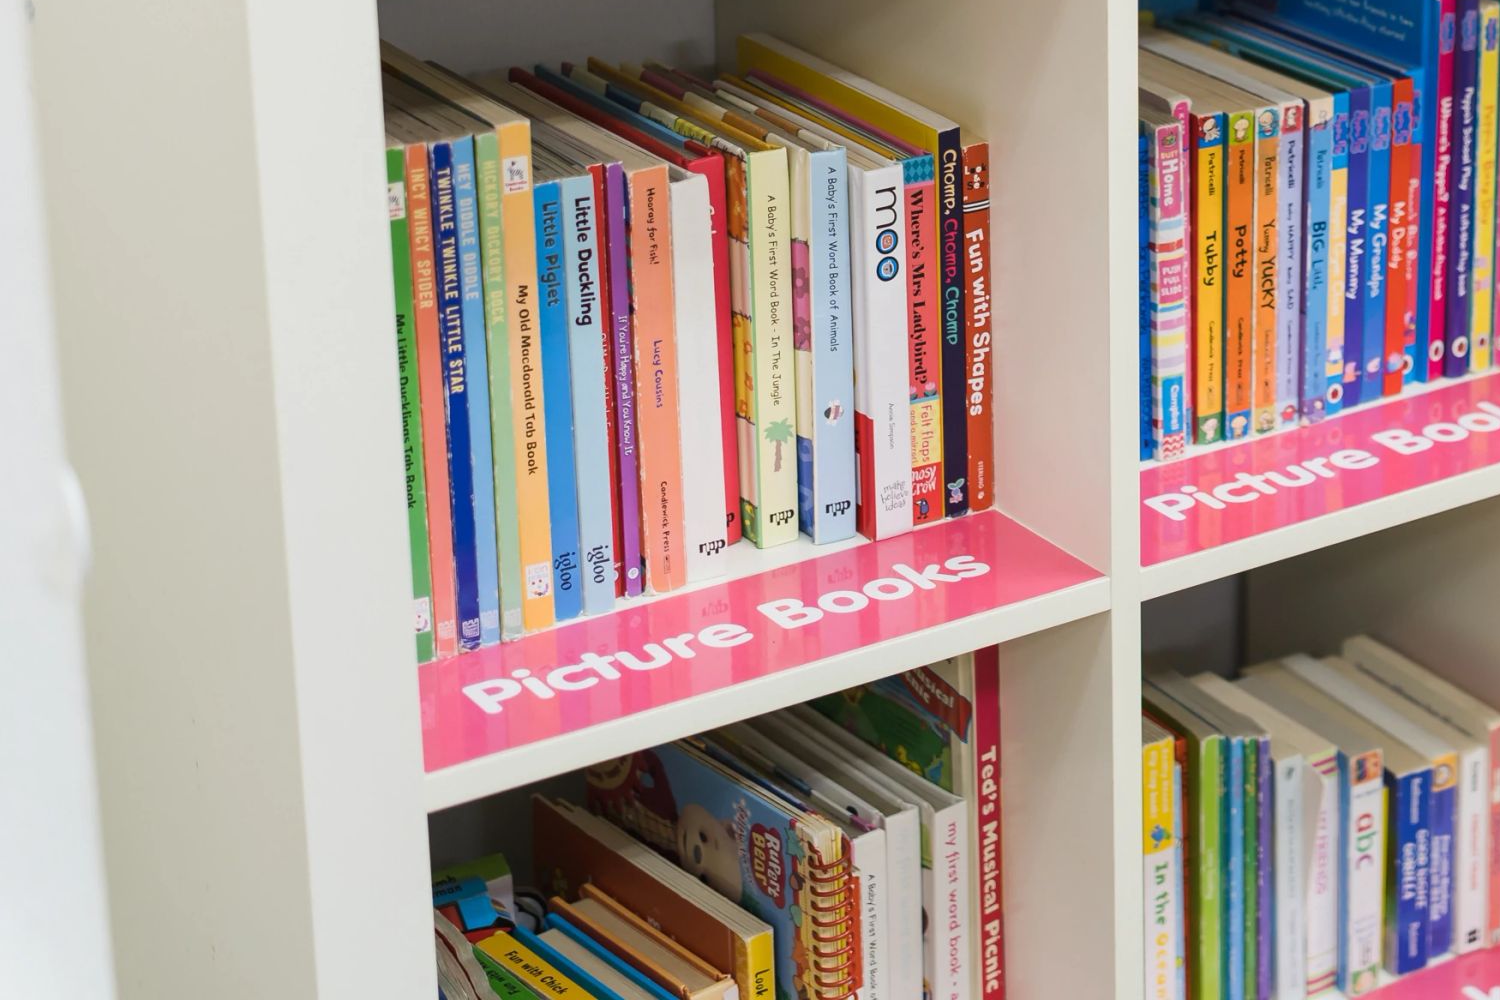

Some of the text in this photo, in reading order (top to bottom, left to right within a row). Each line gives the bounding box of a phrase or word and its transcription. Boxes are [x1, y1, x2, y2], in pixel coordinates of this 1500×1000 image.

[1439, 96, 1452, 152] Where's
[1461, 86, 1475, 124] Peppa's
[1462, 126, 1472, 165] School
[827, 178, 836, 209] Baby's
[1162, 158, 1179, 207] Home
[1435, 155, 1451, 202] Peppa?
[1459, 166, 1472, 190] Play
[410, 168, 433, 309] INCY WINCY SPIDER
[458, 164, 479, 301] HEY DIDDLE DIDDLE
[646, 188, 659, 266] Hooray for Fish!
[766, 205, 777, 237] Baby's
[828, 212, 838, 238] First
[876, 186, 899, 282] moo
[1203, 152, 1218, 286] Patricelli Tubby
[1259, 219, 1275, 254] Yummy
[1312, 222, 1326, 251] BIG
[1388, 201, 1406, 269] My Daddy
[541, 201, 560, 307] Little Piglet
[575, 196, 594, 326] Little Duckling
[769, 240, 778, 265] First
[829, 240, 838, 269] Word
[944, 149, 959, 345] Chomp, Chomp, Chomp
[1233, 224, 1248, 278] Potty
[1345, 209, 1365, 299] My Mummy
[1367, 204, 1388, 298] My Grandpa
[438, 168, 464, 394] TWINKLE TWINKLE LITTLE STAR
[769, 269, 778, 298] Word
[829, 272, 839, 297] Book
[910, 190, 927, 384] Where's Mrs Ladybird?
[1261, 256, 1276, 310] YUCKY
[770, 300, 779, 325] Book
[830, 299, 839, 311] of
[966, 228, 991, 416] Fun with Shapes
[771, 336, 780, 348] In
[830, 315, 839, 352] Animals
[516, 285, 536, 475] My Old Macdonald Tab Book
[620, 355, 631, 381] Happy
[653, 340, 663, 408] Lucy Cousins
[772, 353, 780, 370] The
[622, 382, 630, 400] and
[622, 400, 632, 418] You
[770, 373, 780, 406] Jungle
[1171, 384, 1180, 430] Campbell
[623, 420, 632, 444] Know
[625, 445, 634, 456] It
[919, 404, 934, 462] Felt flaps
[912, 466, 936, 482] nosy
[912, 478, 936, 496] crow
[1143, 444, 1380, 522] Picture
[660, 481, 668, 528] Candlewick
[554, 551, 576, 591] igloo
[586, 544, 610, 584] igloo
[462, 553, 991, 715] Picture Books
[753, 832, 768, 888] Bear
[1356, 812, 1374, 870] abc
[764, 831, 782, 898] Rupert
[868, 874, 875, 882] A
[982, 746, 1002, 994] Ted's Musical Picnic
[867, 883, 876, 913] Baby's
[946, 822, 962, 972] my first word book
[1155, 863, 1170, 924] In the
[504, 950, 568, 996] Fun with Chick
[869, 940, 877, 966] Word
[754, 968, 769, 997] Look
[869, 966, 877, 990] Book
